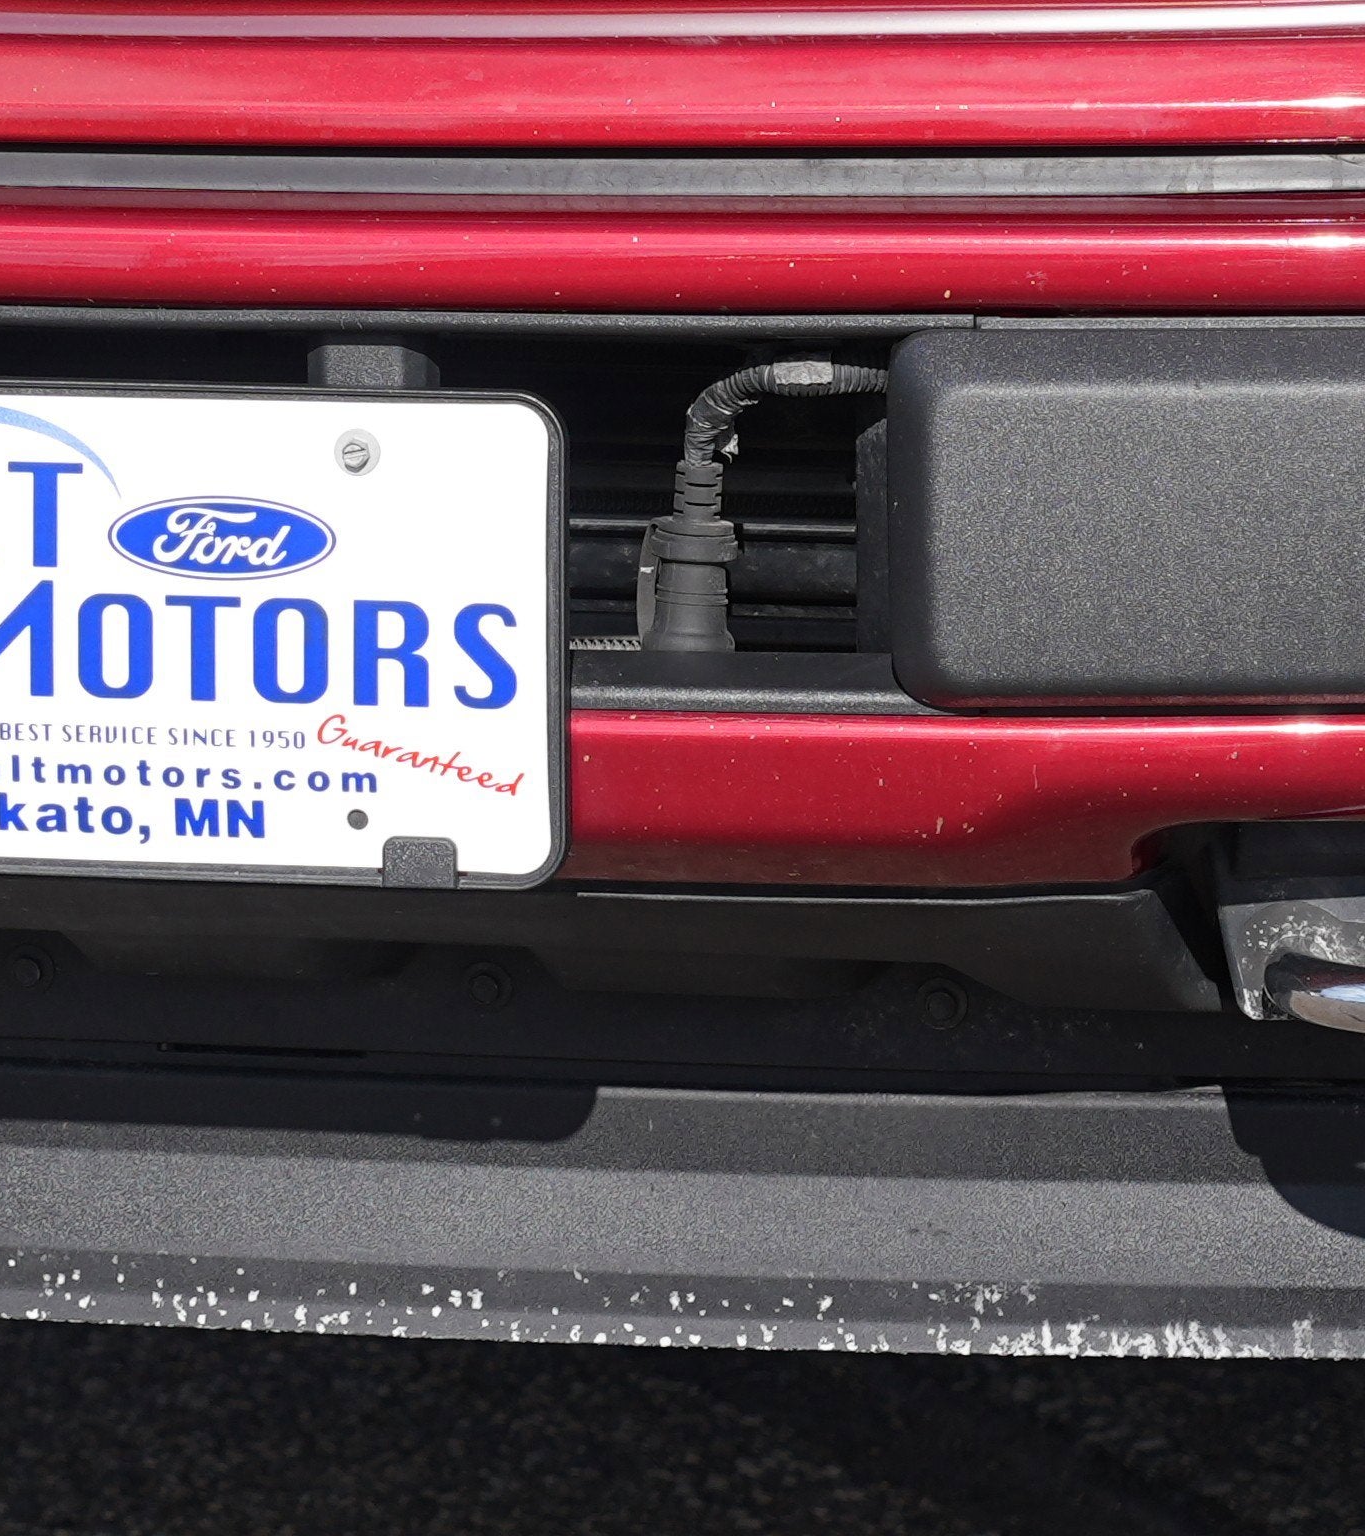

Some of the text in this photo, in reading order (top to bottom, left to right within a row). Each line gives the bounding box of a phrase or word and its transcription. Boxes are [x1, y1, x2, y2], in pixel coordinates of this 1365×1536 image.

[152, 506, 289, 567] Ford
[0, 722, 52, 742] BEST
[62, 724, 157, 746] SERVICE
[168, 727, 236, 748] SINCE
[250, 730, 306, 750] 1950
[316, 714, 525, 797] Guaranteed
[174, 797, 266, 839] MN
